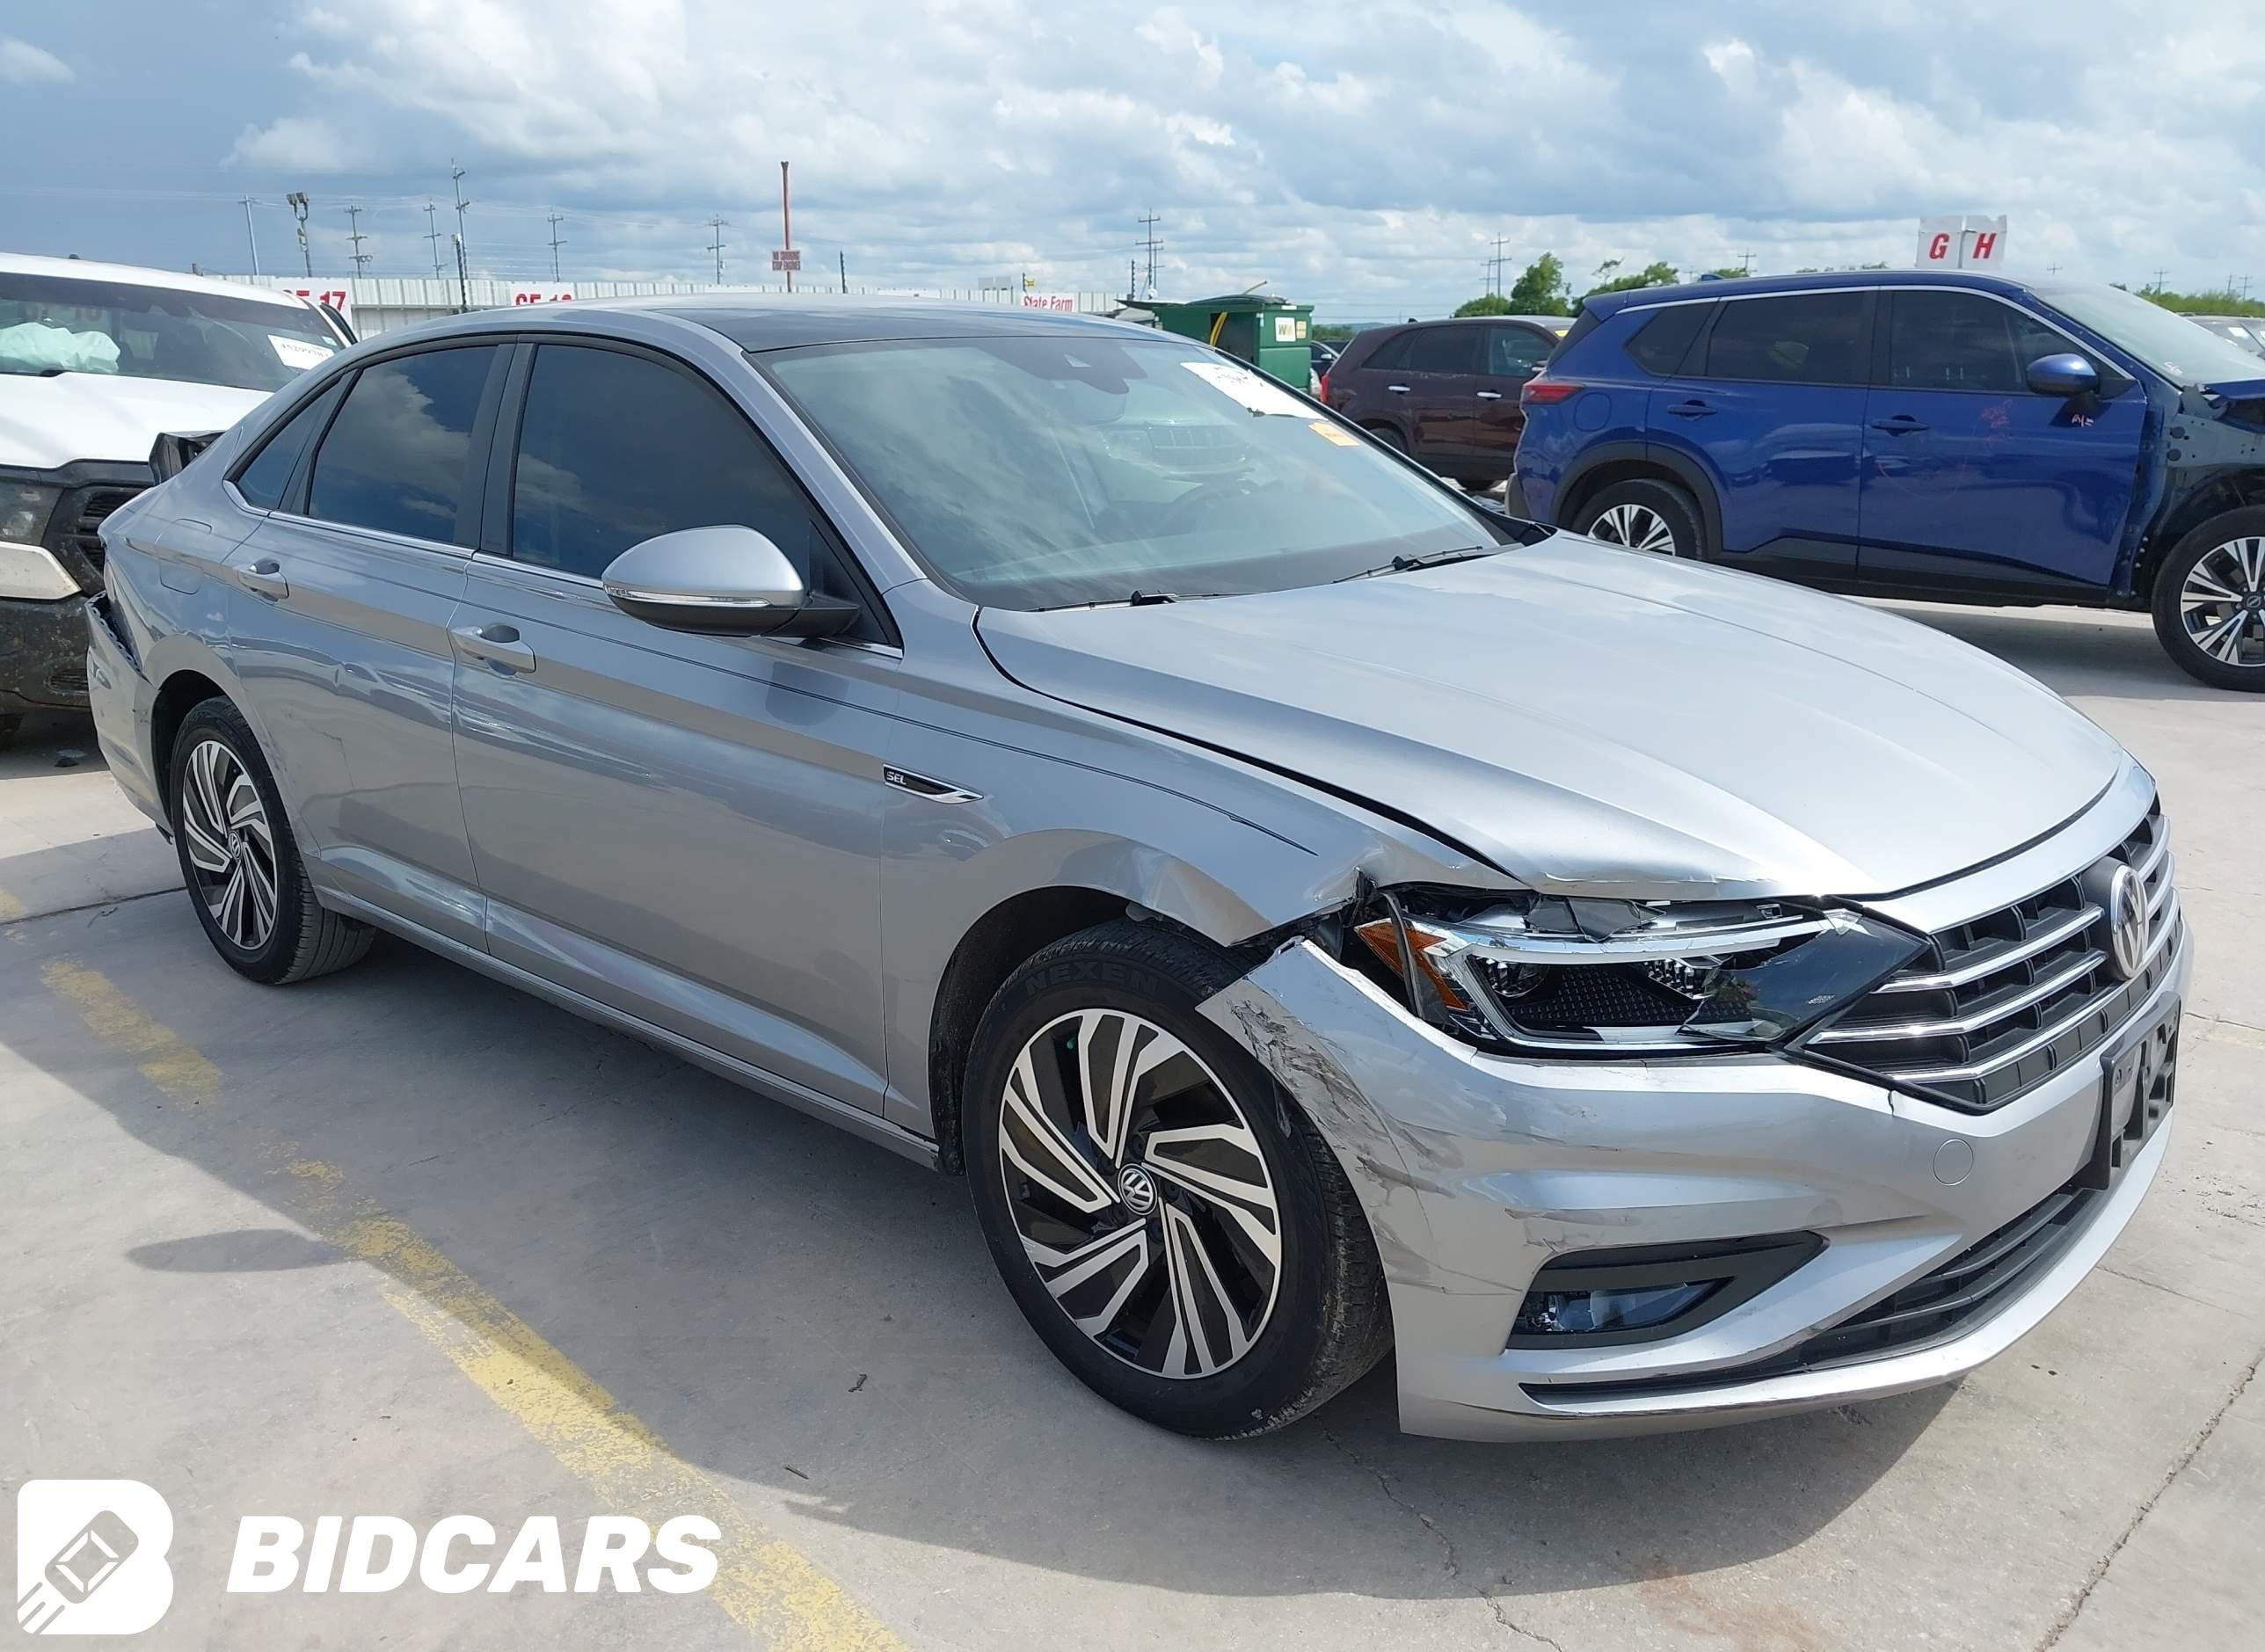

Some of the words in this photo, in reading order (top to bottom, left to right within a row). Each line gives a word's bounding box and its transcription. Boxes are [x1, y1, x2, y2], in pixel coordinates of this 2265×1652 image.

[1929, 233, 1949, 259] G
[1972, 232, 1997, 258] H
[319, 290, 346, 311] 17
[1023, 295, 1047, 308] State
[1051, 295, 1074, 310] Farm
[886, 771, 907, 786] SEL
[1024, 960, 1160, 996] NEXEN
